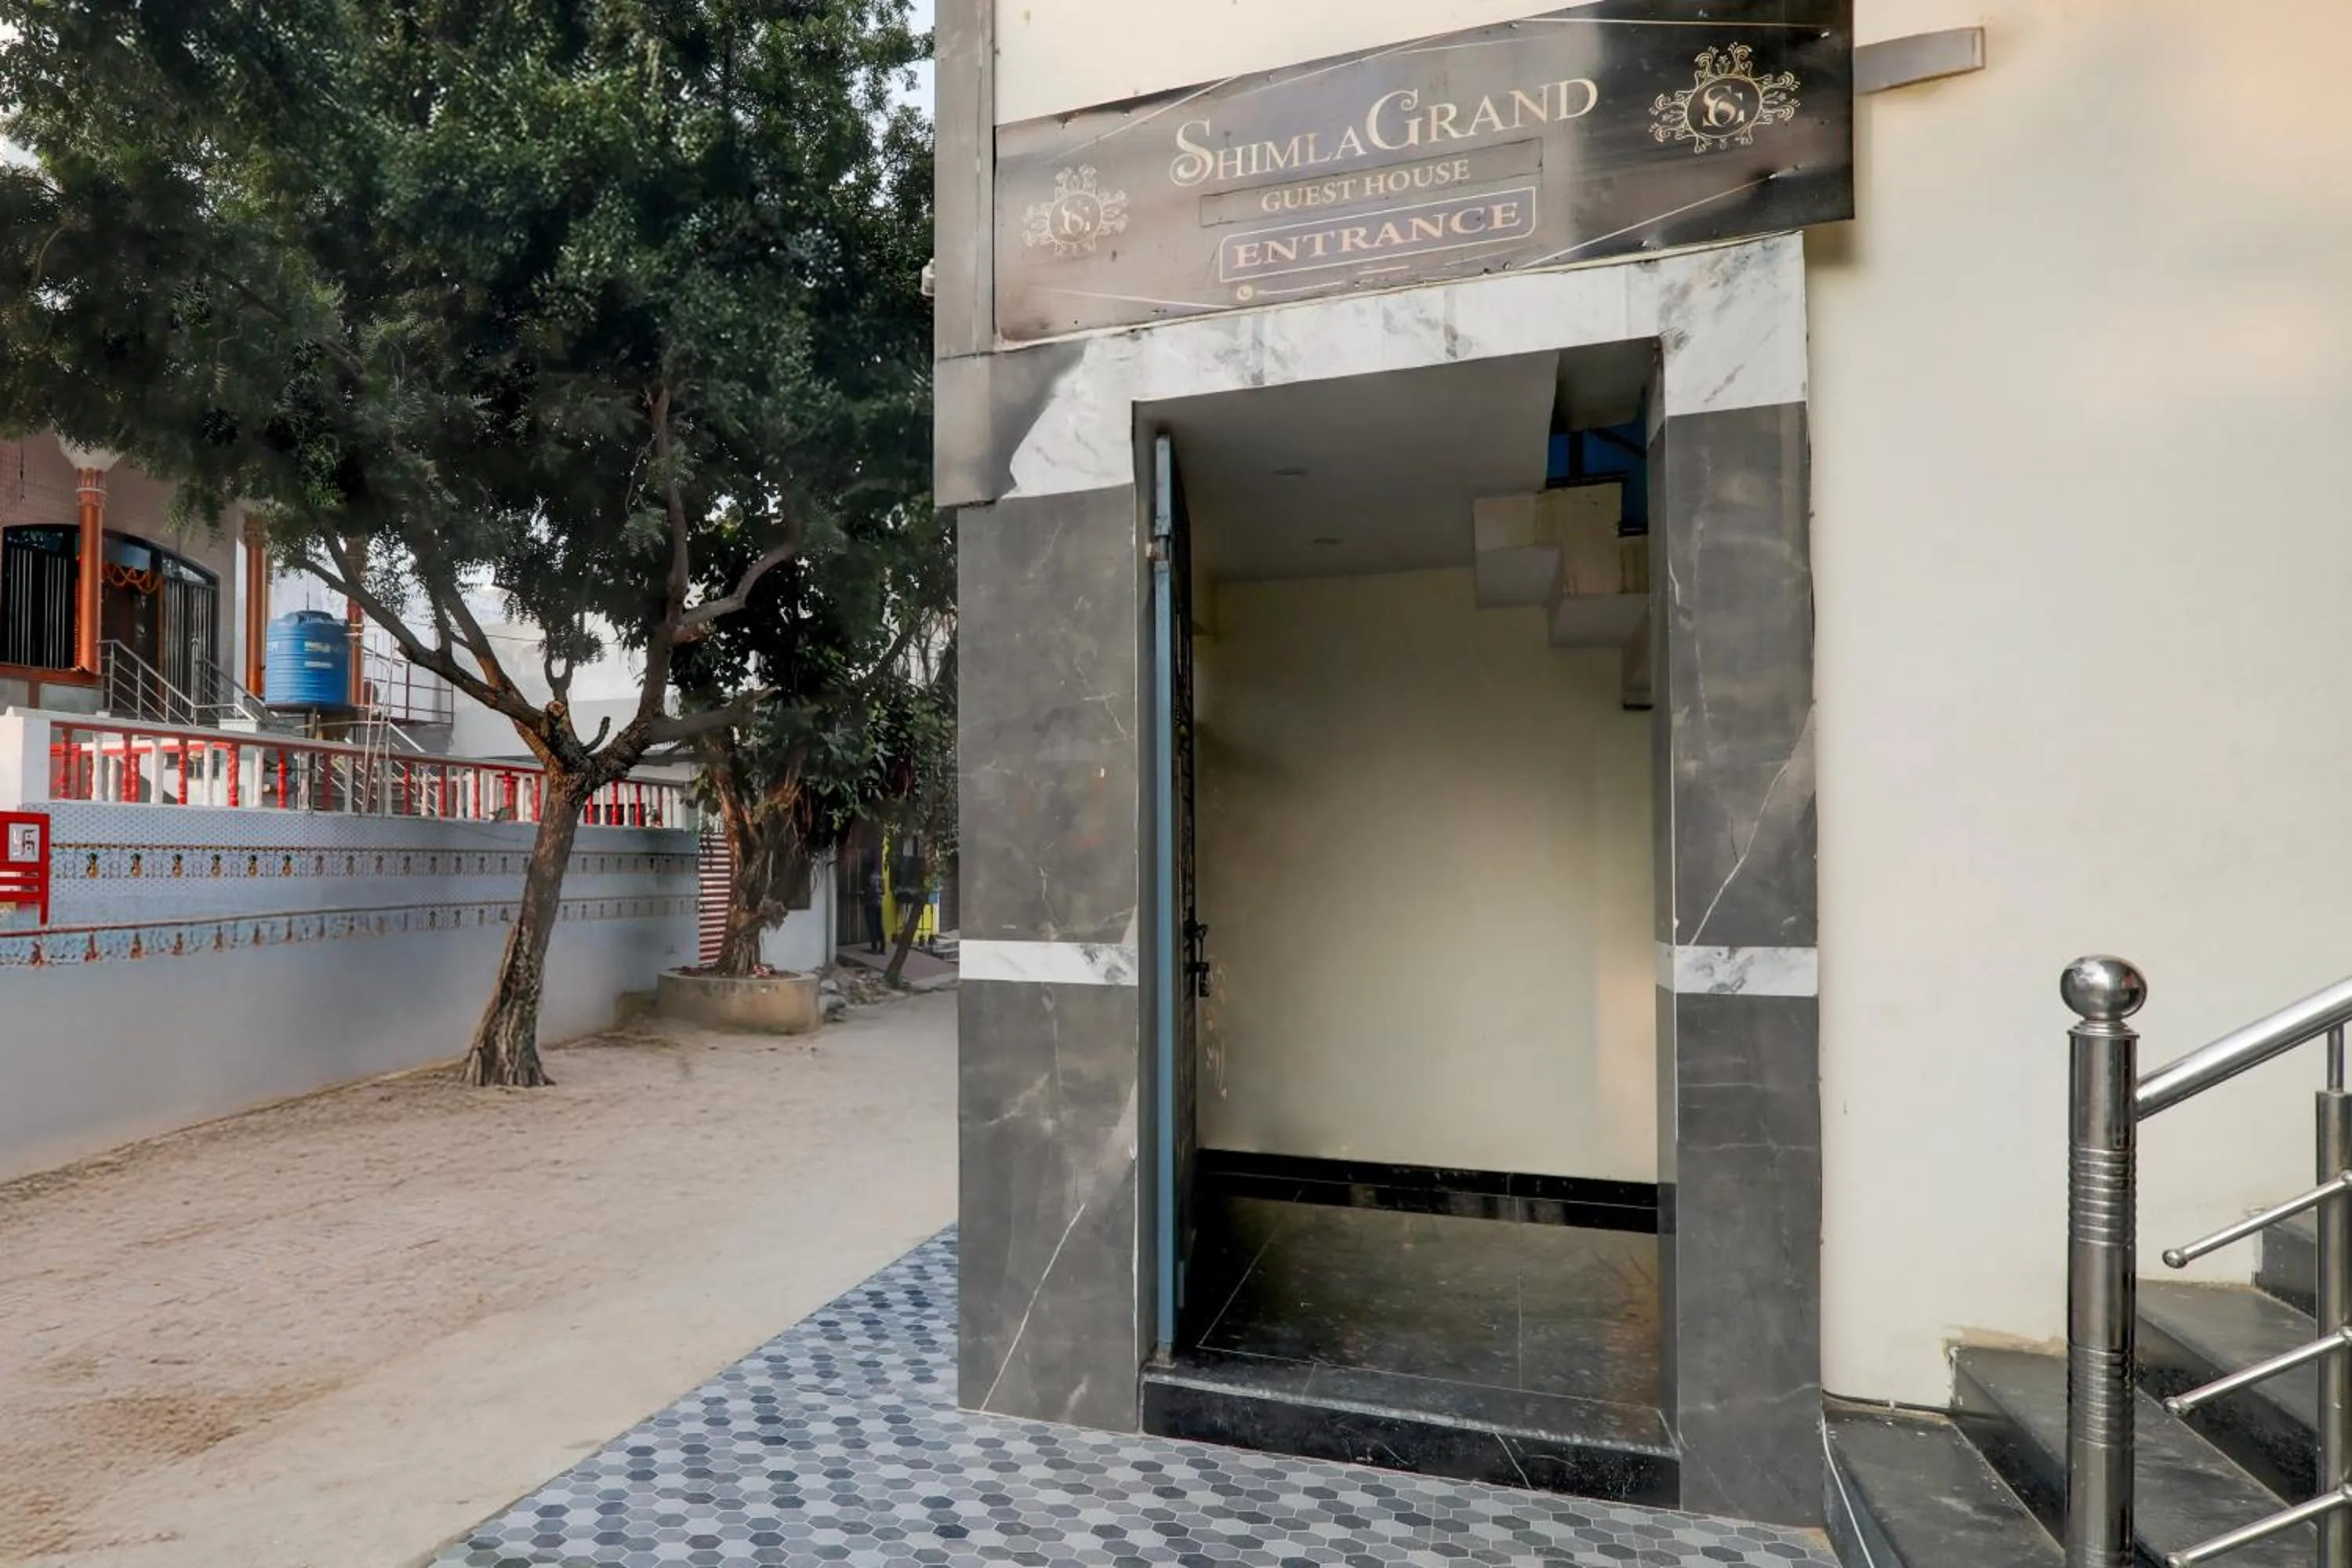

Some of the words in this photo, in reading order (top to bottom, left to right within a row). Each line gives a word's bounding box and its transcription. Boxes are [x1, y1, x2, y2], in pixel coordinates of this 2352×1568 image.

[1366, 78, 1598, 150] GRAND
[1261, 180, 1356, 212] GUEST
[1364, 159, 1471, 196] HOUSE
[1232, 202, 1521, 269] ENTRANCE
